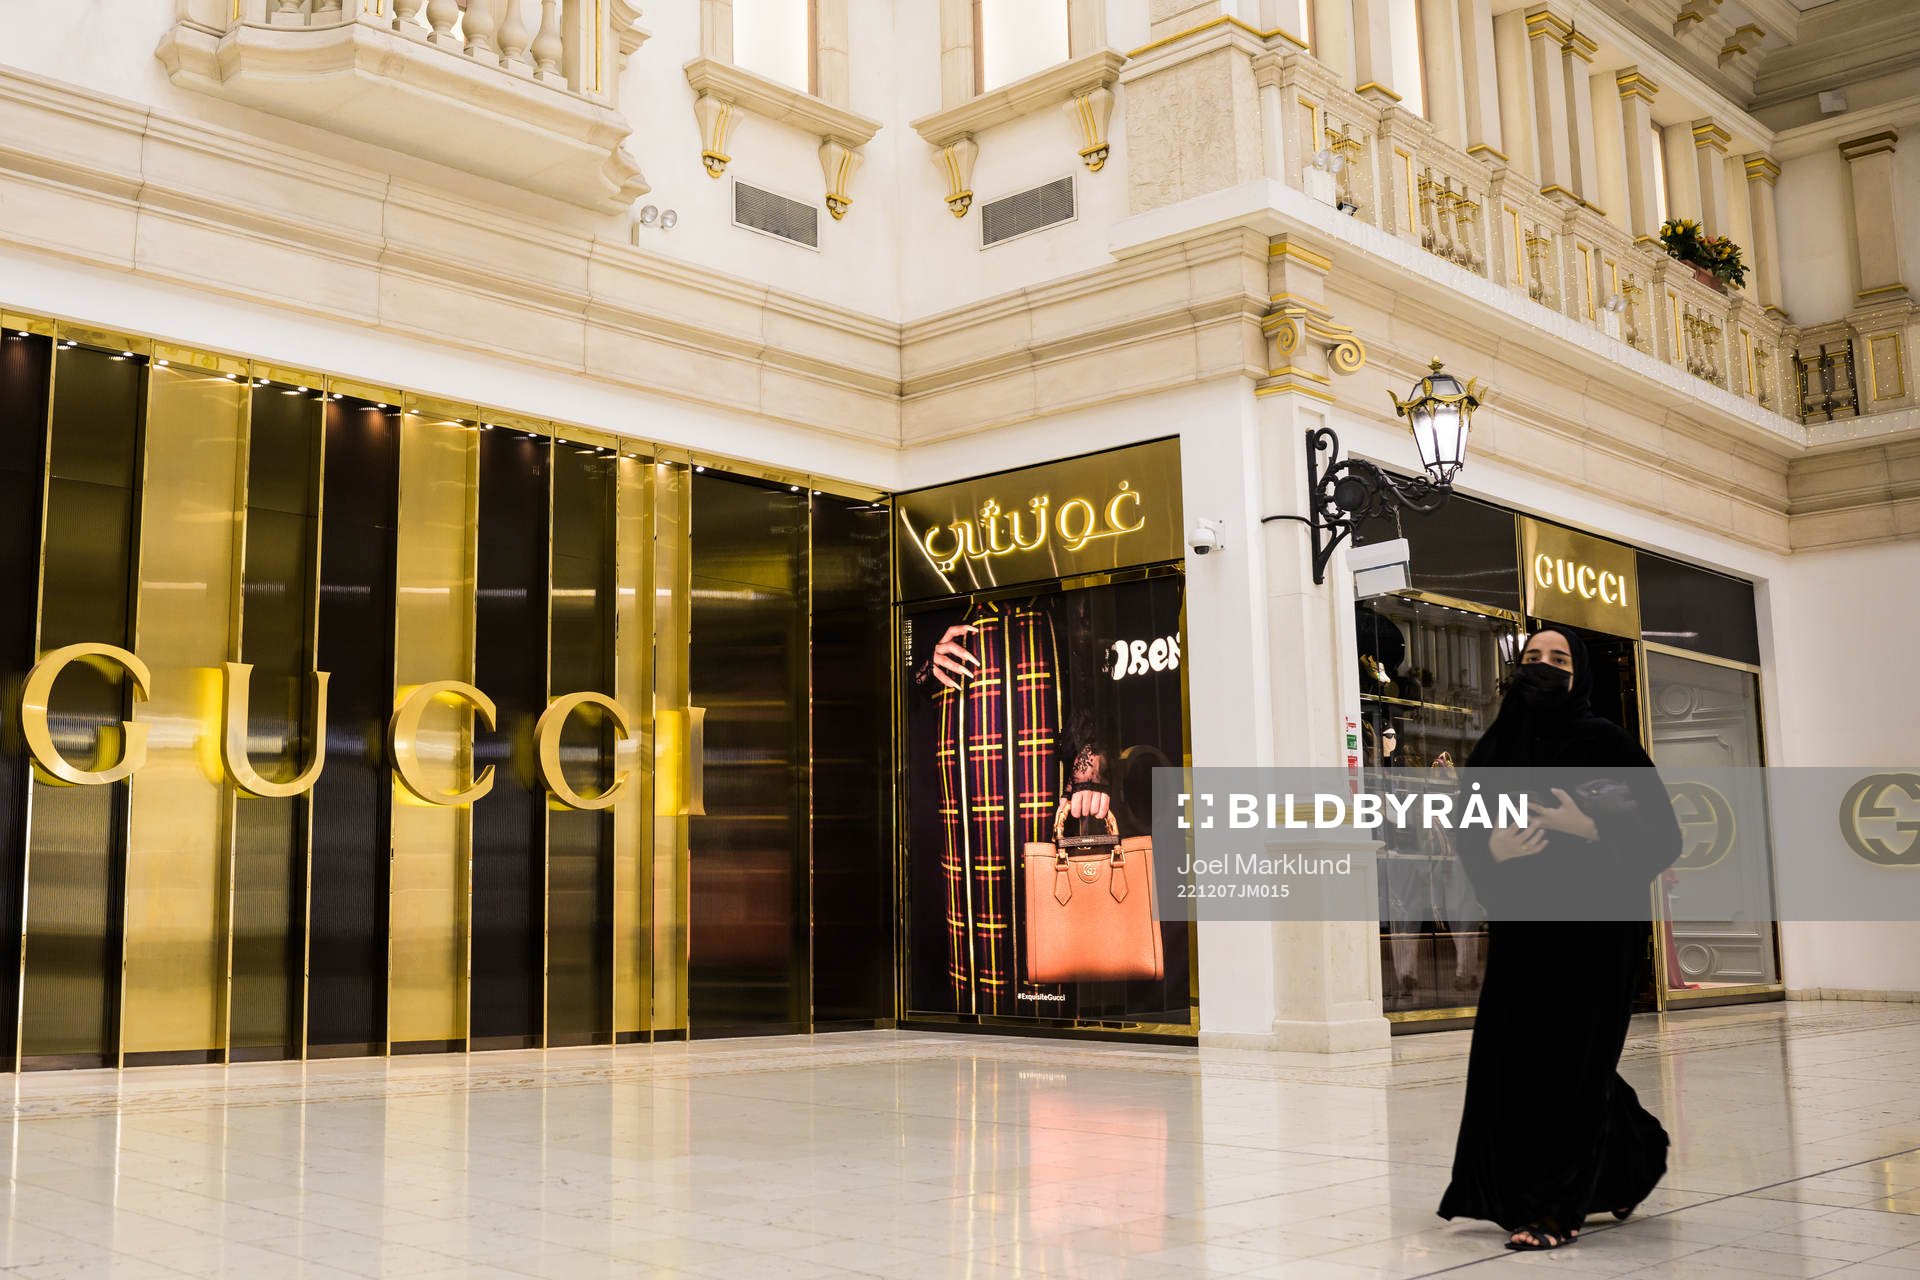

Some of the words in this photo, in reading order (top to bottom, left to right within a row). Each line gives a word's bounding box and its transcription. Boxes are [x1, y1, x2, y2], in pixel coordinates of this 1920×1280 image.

[925, 480, 1146, 572] غوتشي
[1534, 553, 1628, 607] GUCCI
[21, 642, 707, 817] GUCCI
